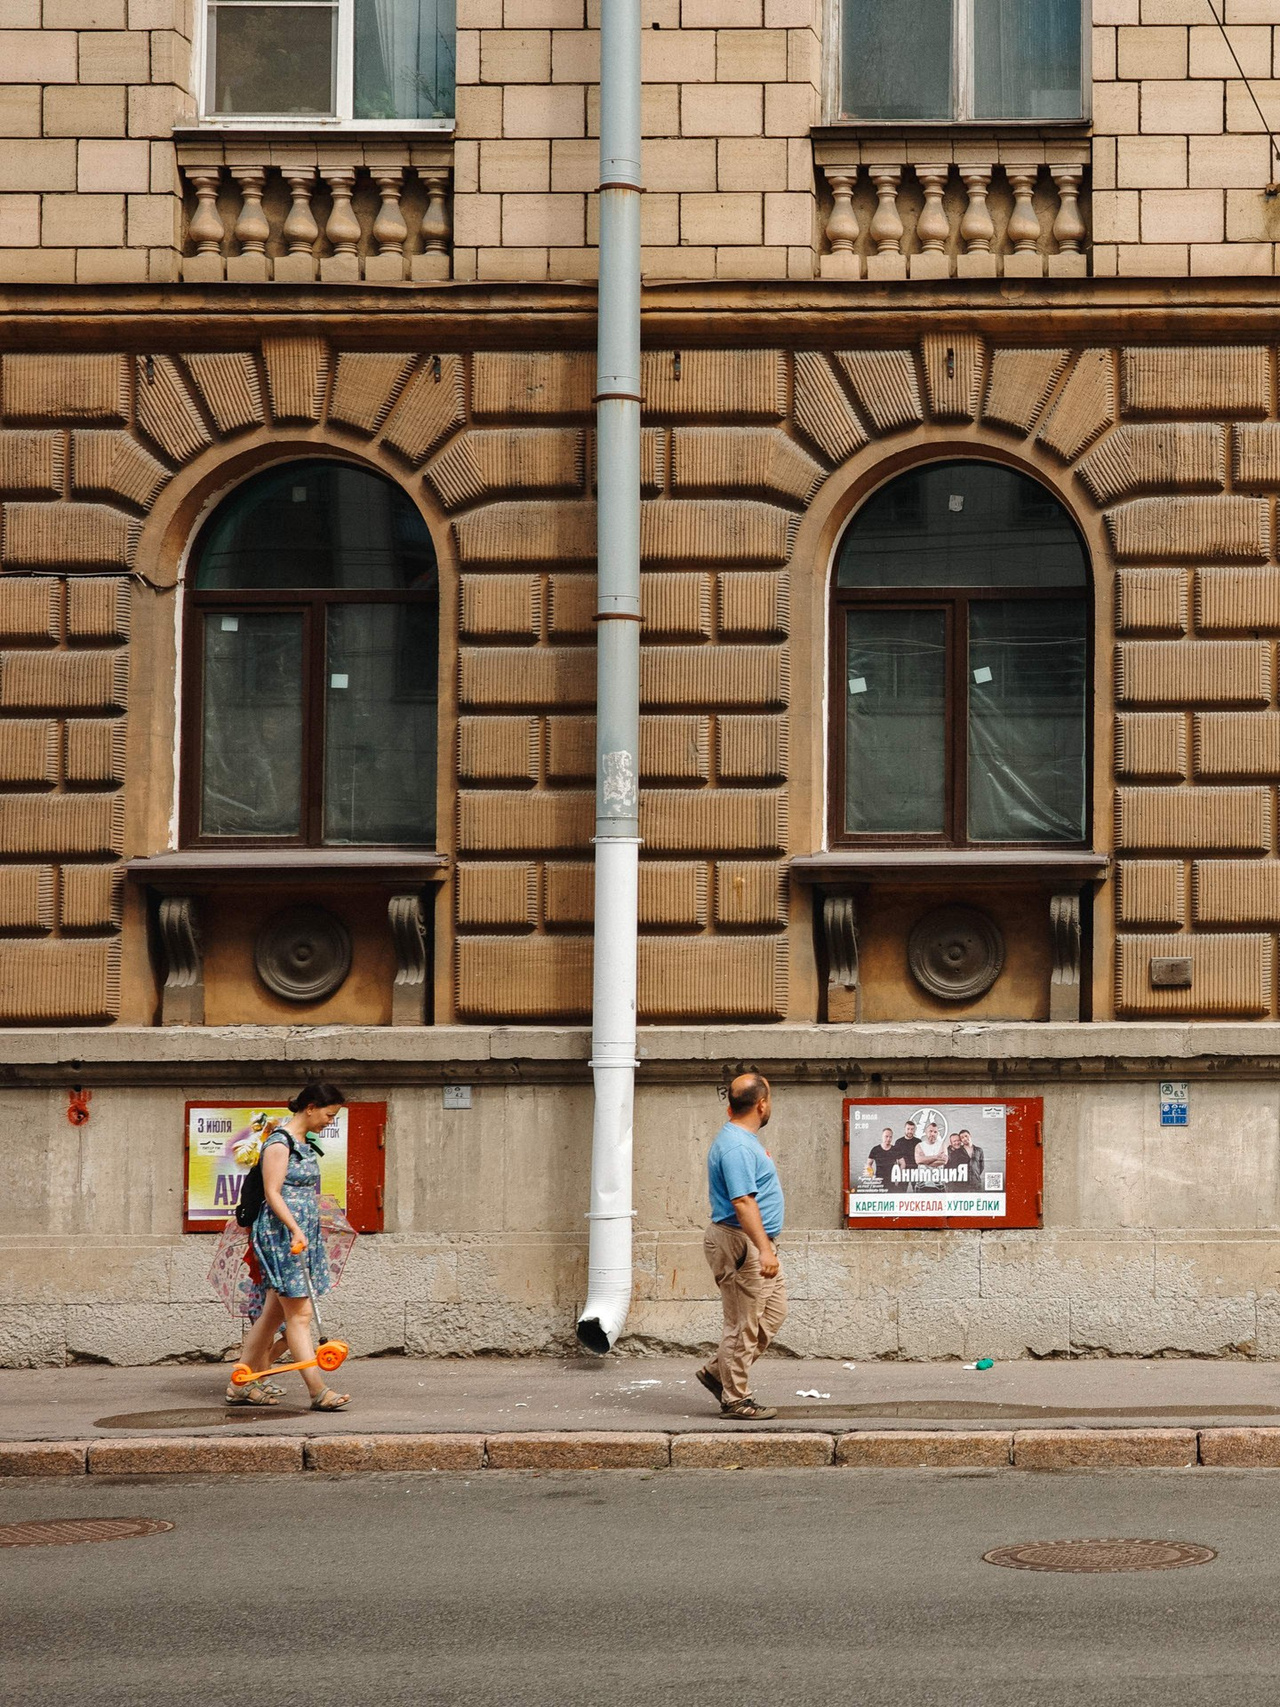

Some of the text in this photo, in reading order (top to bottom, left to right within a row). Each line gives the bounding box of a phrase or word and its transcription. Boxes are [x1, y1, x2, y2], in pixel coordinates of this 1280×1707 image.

[854, 1110, 861, 1120] 6
[197, 1117, 204, 1133] 3
[855, 1198, 1000, 1212] КАРЕЛИЯ РУСКЕАЛА ХУТОР ЁЛКИ
